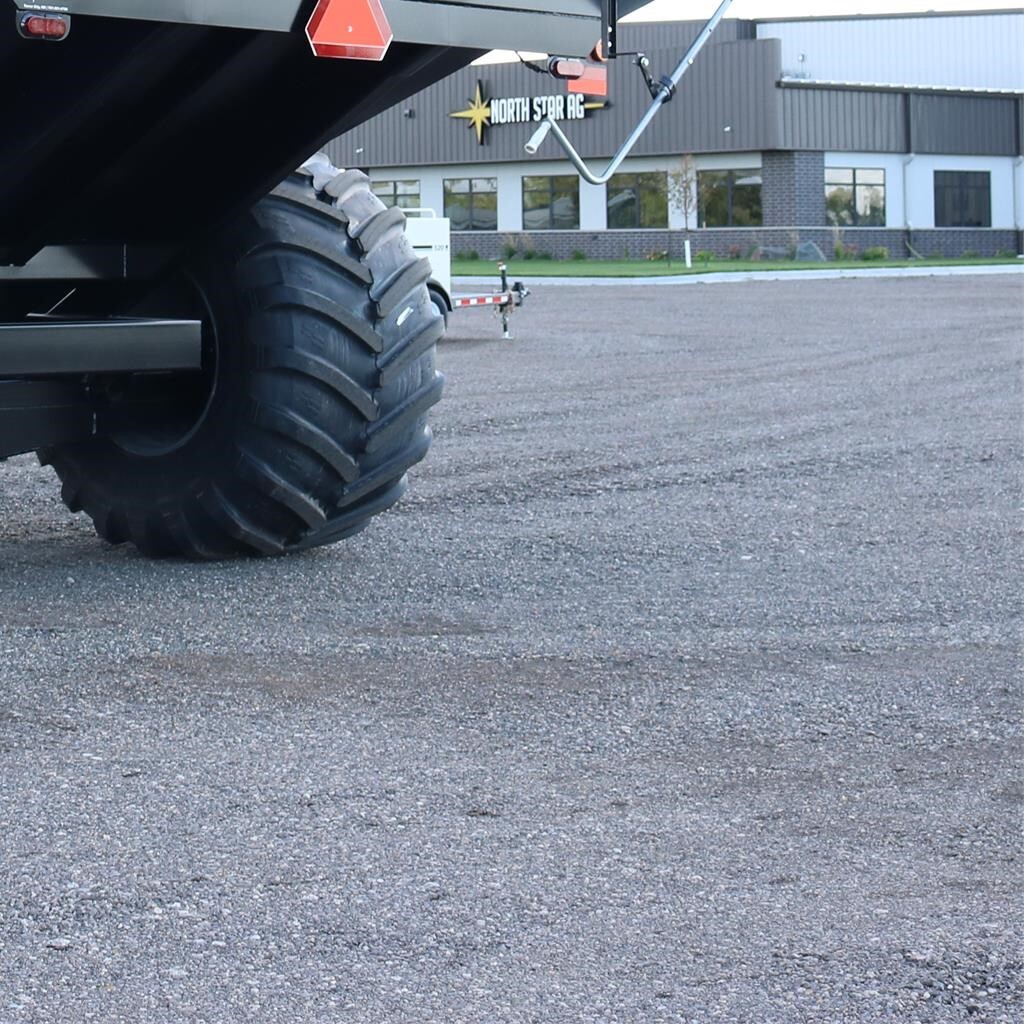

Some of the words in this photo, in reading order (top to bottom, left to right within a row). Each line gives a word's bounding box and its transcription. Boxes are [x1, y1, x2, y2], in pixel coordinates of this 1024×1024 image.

[490, 96, 530, 124] NORTH
[532, 95, 564, 122] STAR
[567, 93, 585, 120] AG
